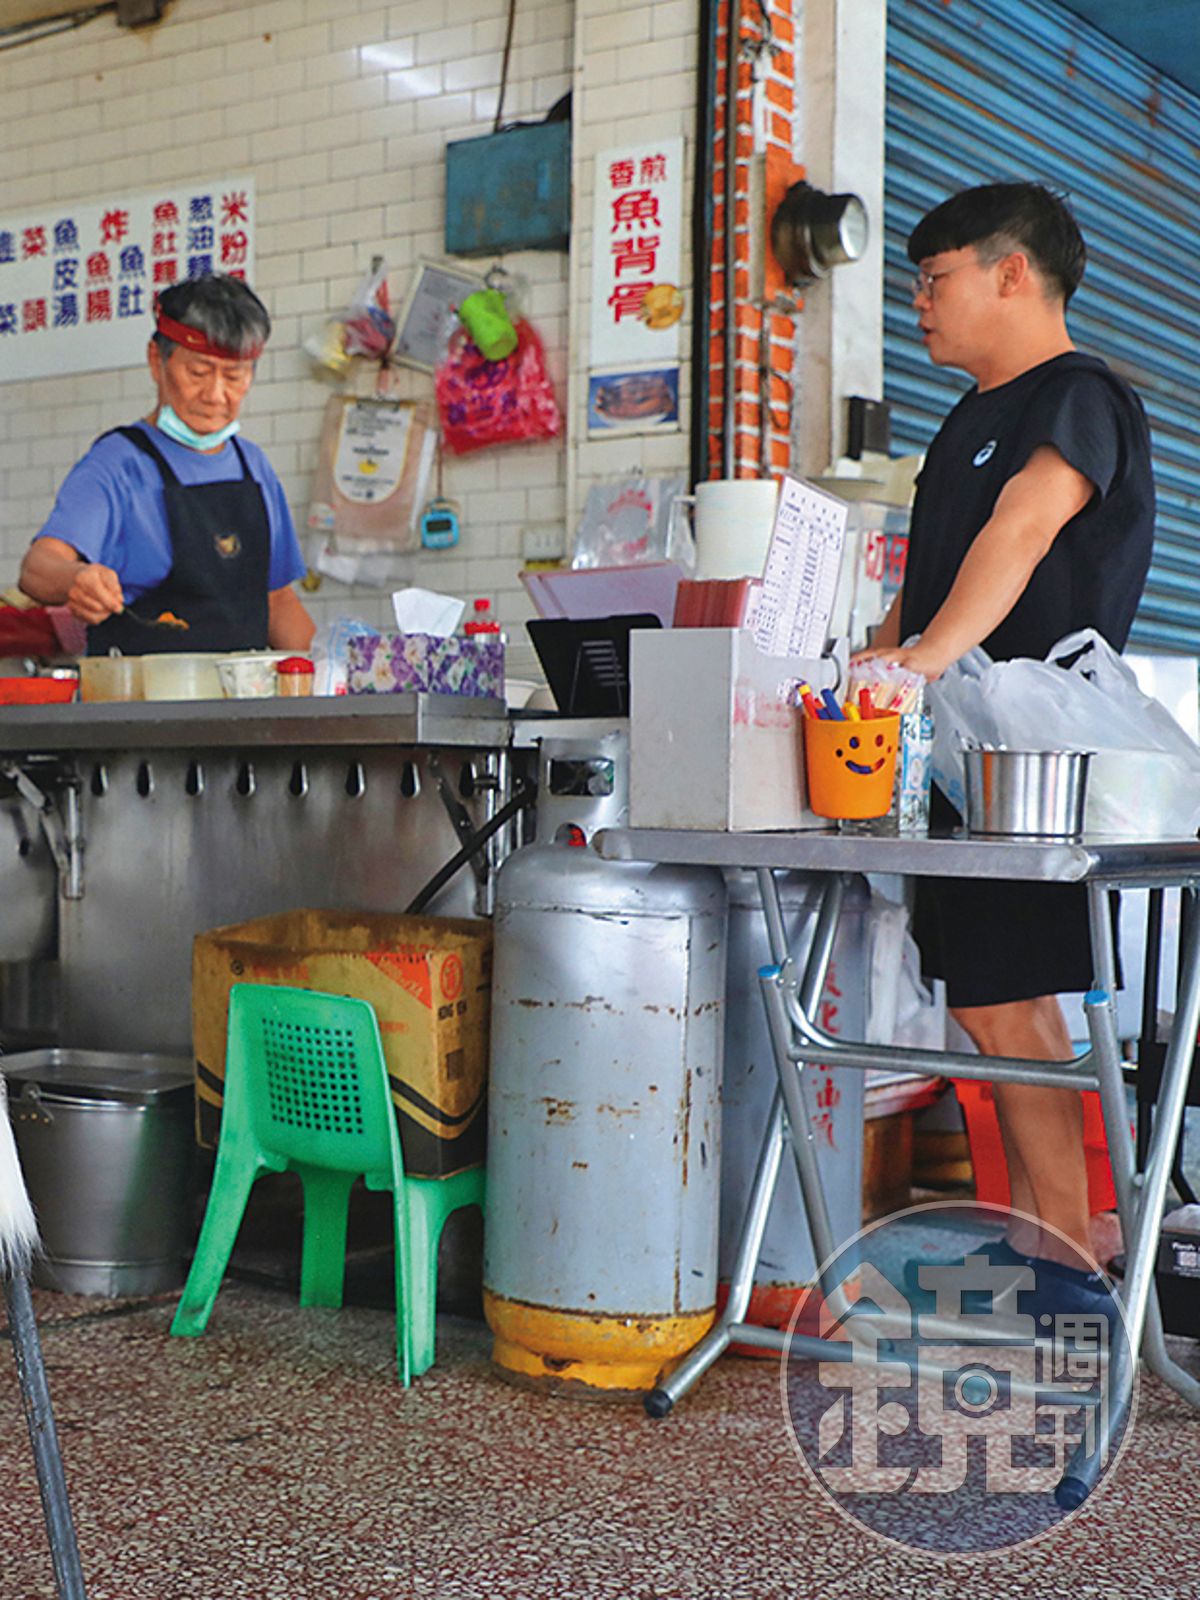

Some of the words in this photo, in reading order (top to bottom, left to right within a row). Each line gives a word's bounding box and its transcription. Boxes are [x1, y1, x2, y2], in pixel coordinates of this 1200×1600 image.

[608, 152, 668, 188] 香煎
[98, 207, 131, 246] 炸
[52, 216, 81, 329] 魚皮湯
[116, 244, 147, 319] 魚肚
